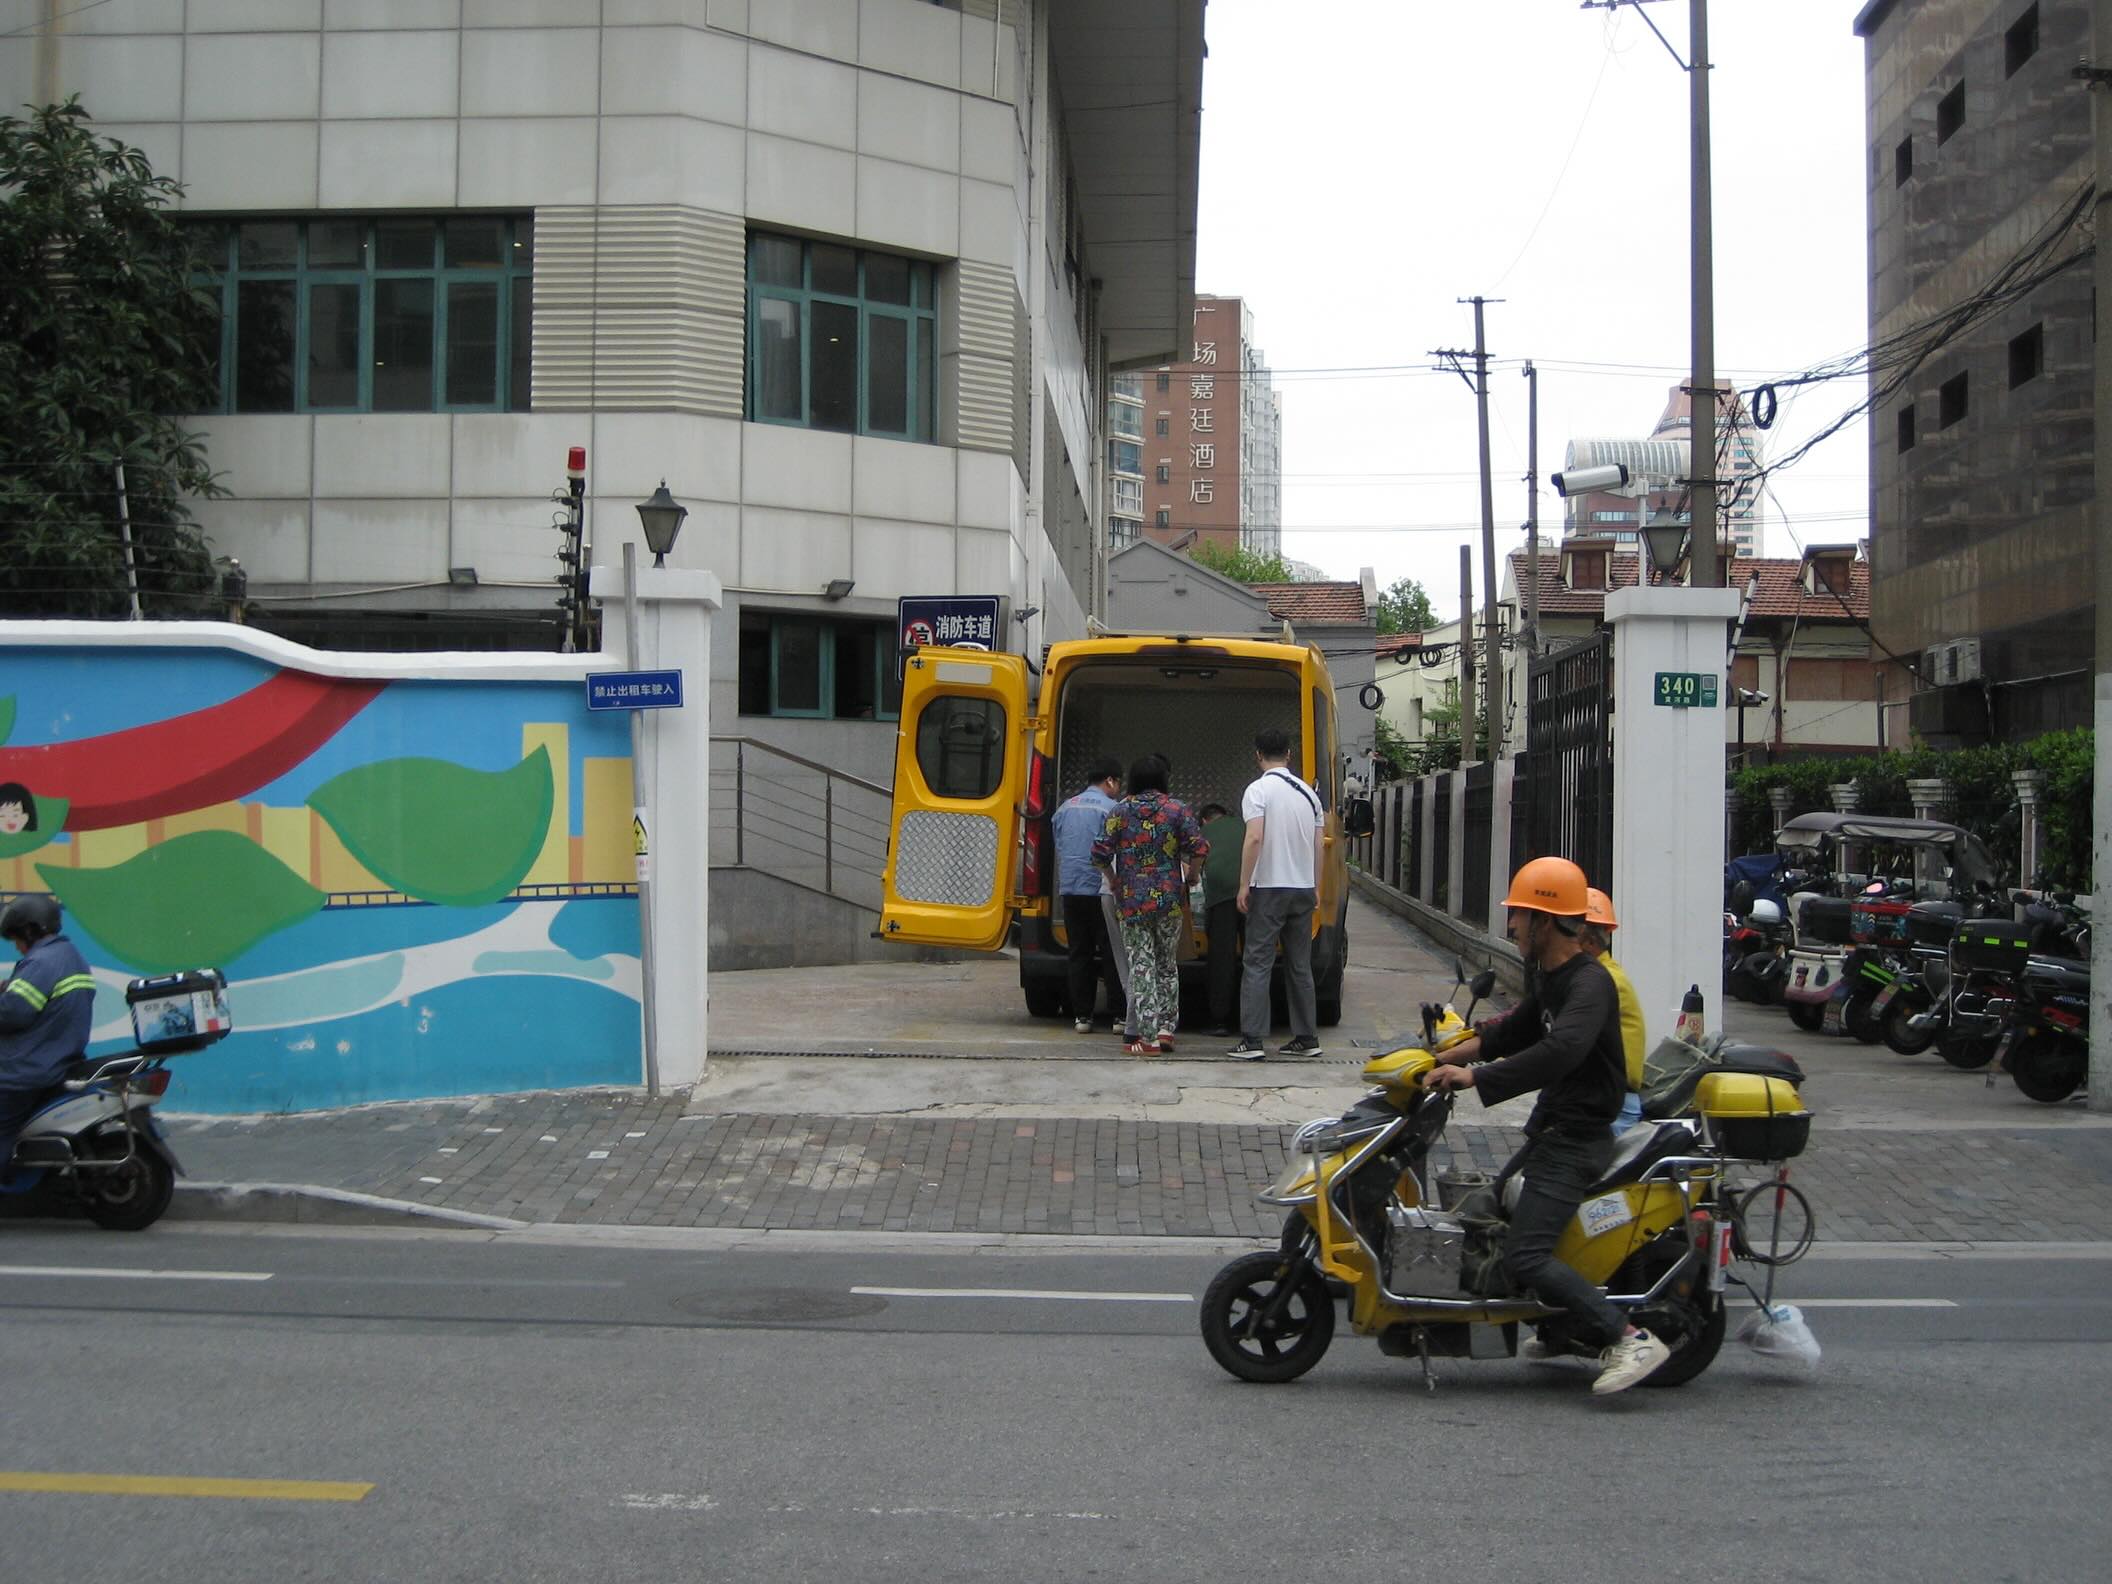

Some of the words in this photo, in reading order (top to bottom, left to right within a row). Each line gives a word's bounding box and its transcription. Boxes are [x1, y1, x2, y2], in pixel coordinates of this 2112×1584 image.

[935, 615, 992, 639] 消防车道
[594, 683, 674, 698] 禁止出租车驶入
[1660, 676, 1695, 695] 340
